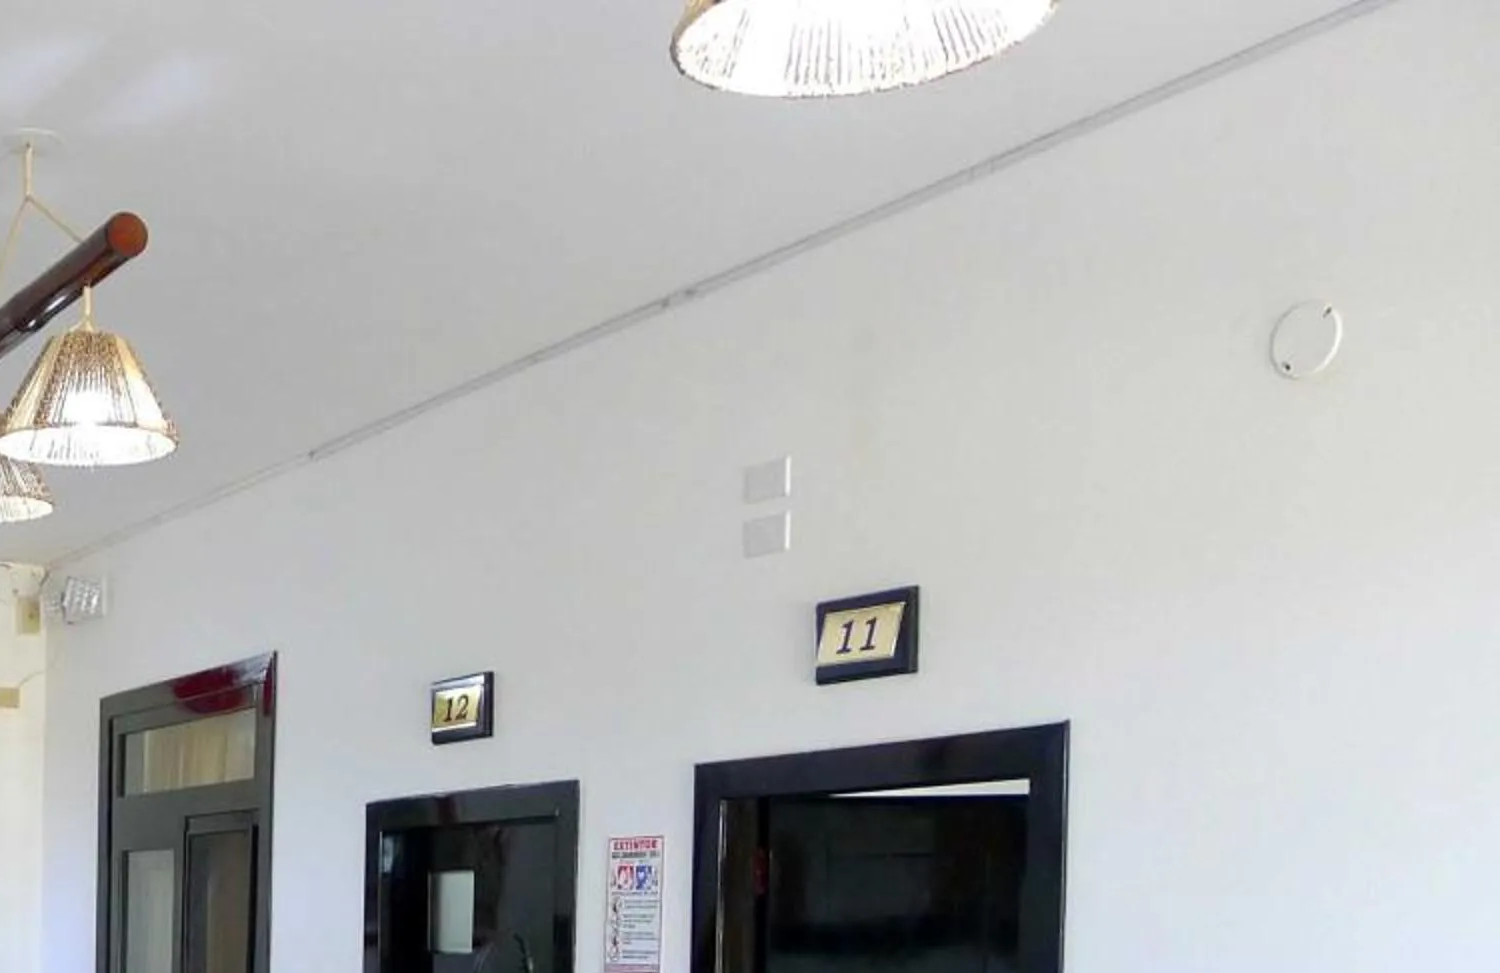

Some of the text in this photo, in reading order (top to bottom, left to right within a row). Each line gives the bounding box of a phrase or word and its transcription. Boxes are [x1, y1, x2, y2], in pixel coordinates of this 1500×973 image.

[836, 616, 878, 655] 11
[443, 692, 469, 723] 12
[613, 839, 657, 851] EXTINTOR
